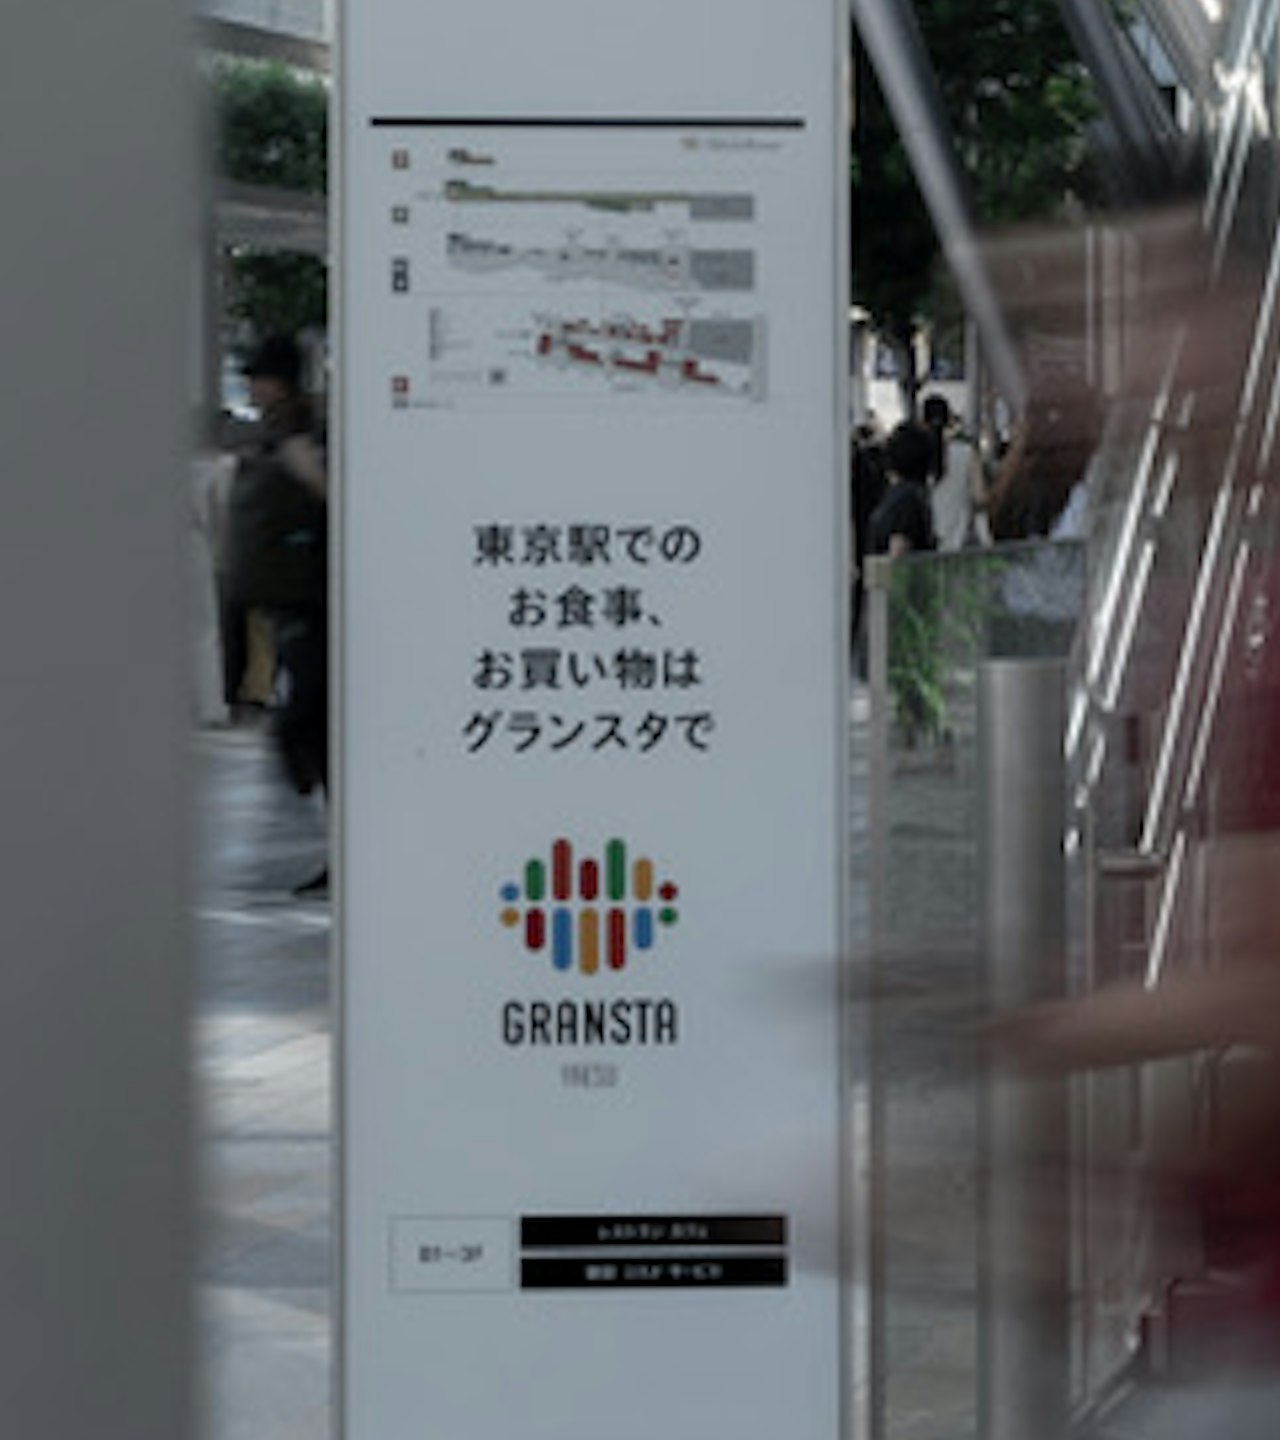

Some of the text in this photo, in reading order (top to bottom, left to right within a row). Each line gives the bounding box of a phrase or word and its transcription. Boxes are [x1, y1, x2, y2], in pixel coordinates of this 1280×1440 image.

[472, 524, 701, 568] 東京駅での
[507, 585, 664, 630] お食事、
[471, 648, 702, 692] お買い物は
[461, 710, 716, 755] グランスタで
[502, 999, 680, 1046] GRANSTA
